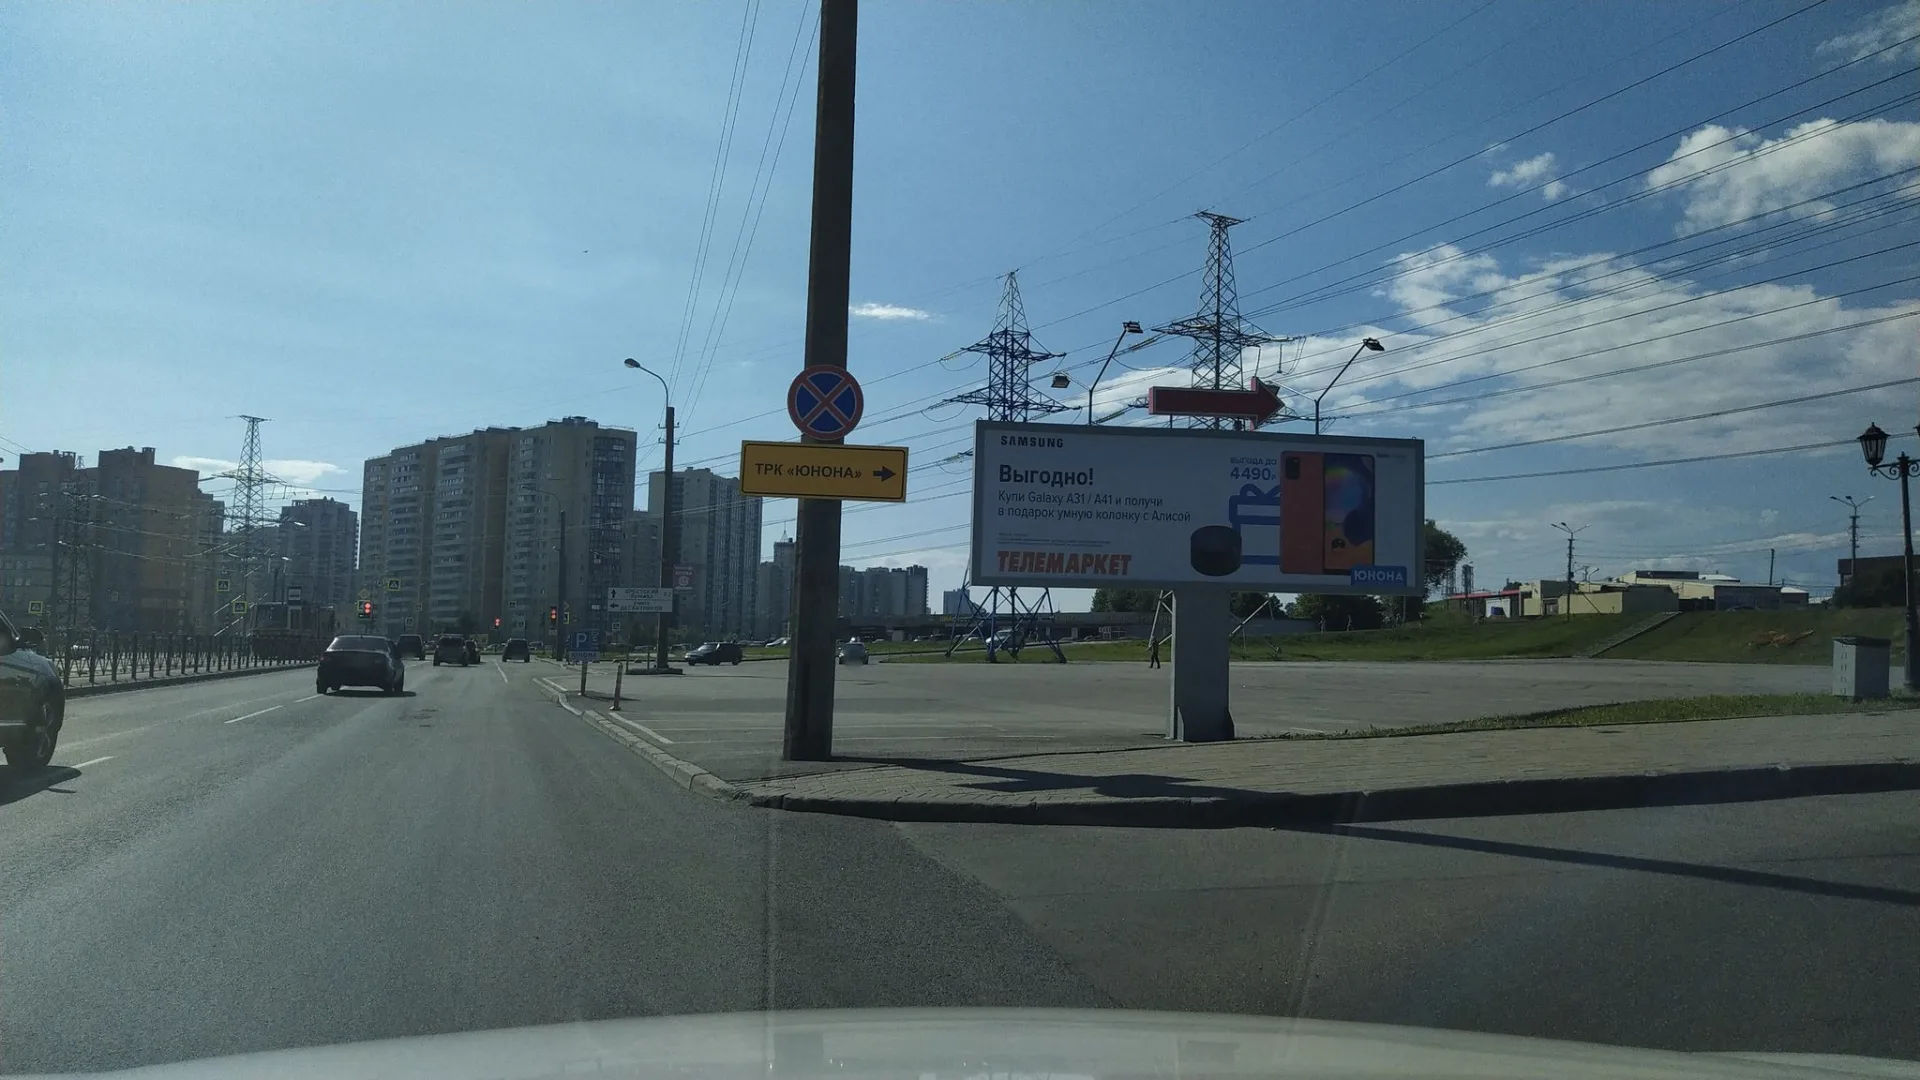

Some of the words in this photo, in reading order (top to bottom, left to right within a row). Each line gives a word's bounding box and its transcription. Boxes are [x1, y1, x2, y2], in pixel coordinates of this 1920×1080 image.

[1000, 435, 1064, 448] SAMSUNG
[755, 462, 784, 476] ТРК
[787, 464, 862, 479] «ЮНОНА»
[999, 464, 1094, 487] Выгодно!
[998, 490, 1025, 504] Купи
[1028, 491, 1064, 506] Galaxy
[1115, 497, 1122, 506] и
[1124, 497, 1163, 508] получи
[998, 507, 1004, 516] в
[1007, 507, 1055, 519] подарок
[1057, 509, 1093, 520] умную
[1095, 511, 1140, 523] колонку
[1143, 512, 1148, 521] с
[1151, 510, 1191, 522] Алисой
[997, 550, 1132, 576] ТЕЛЕМАРКЕТ
[1354, 569, 1404, 581] ЮНОНА
